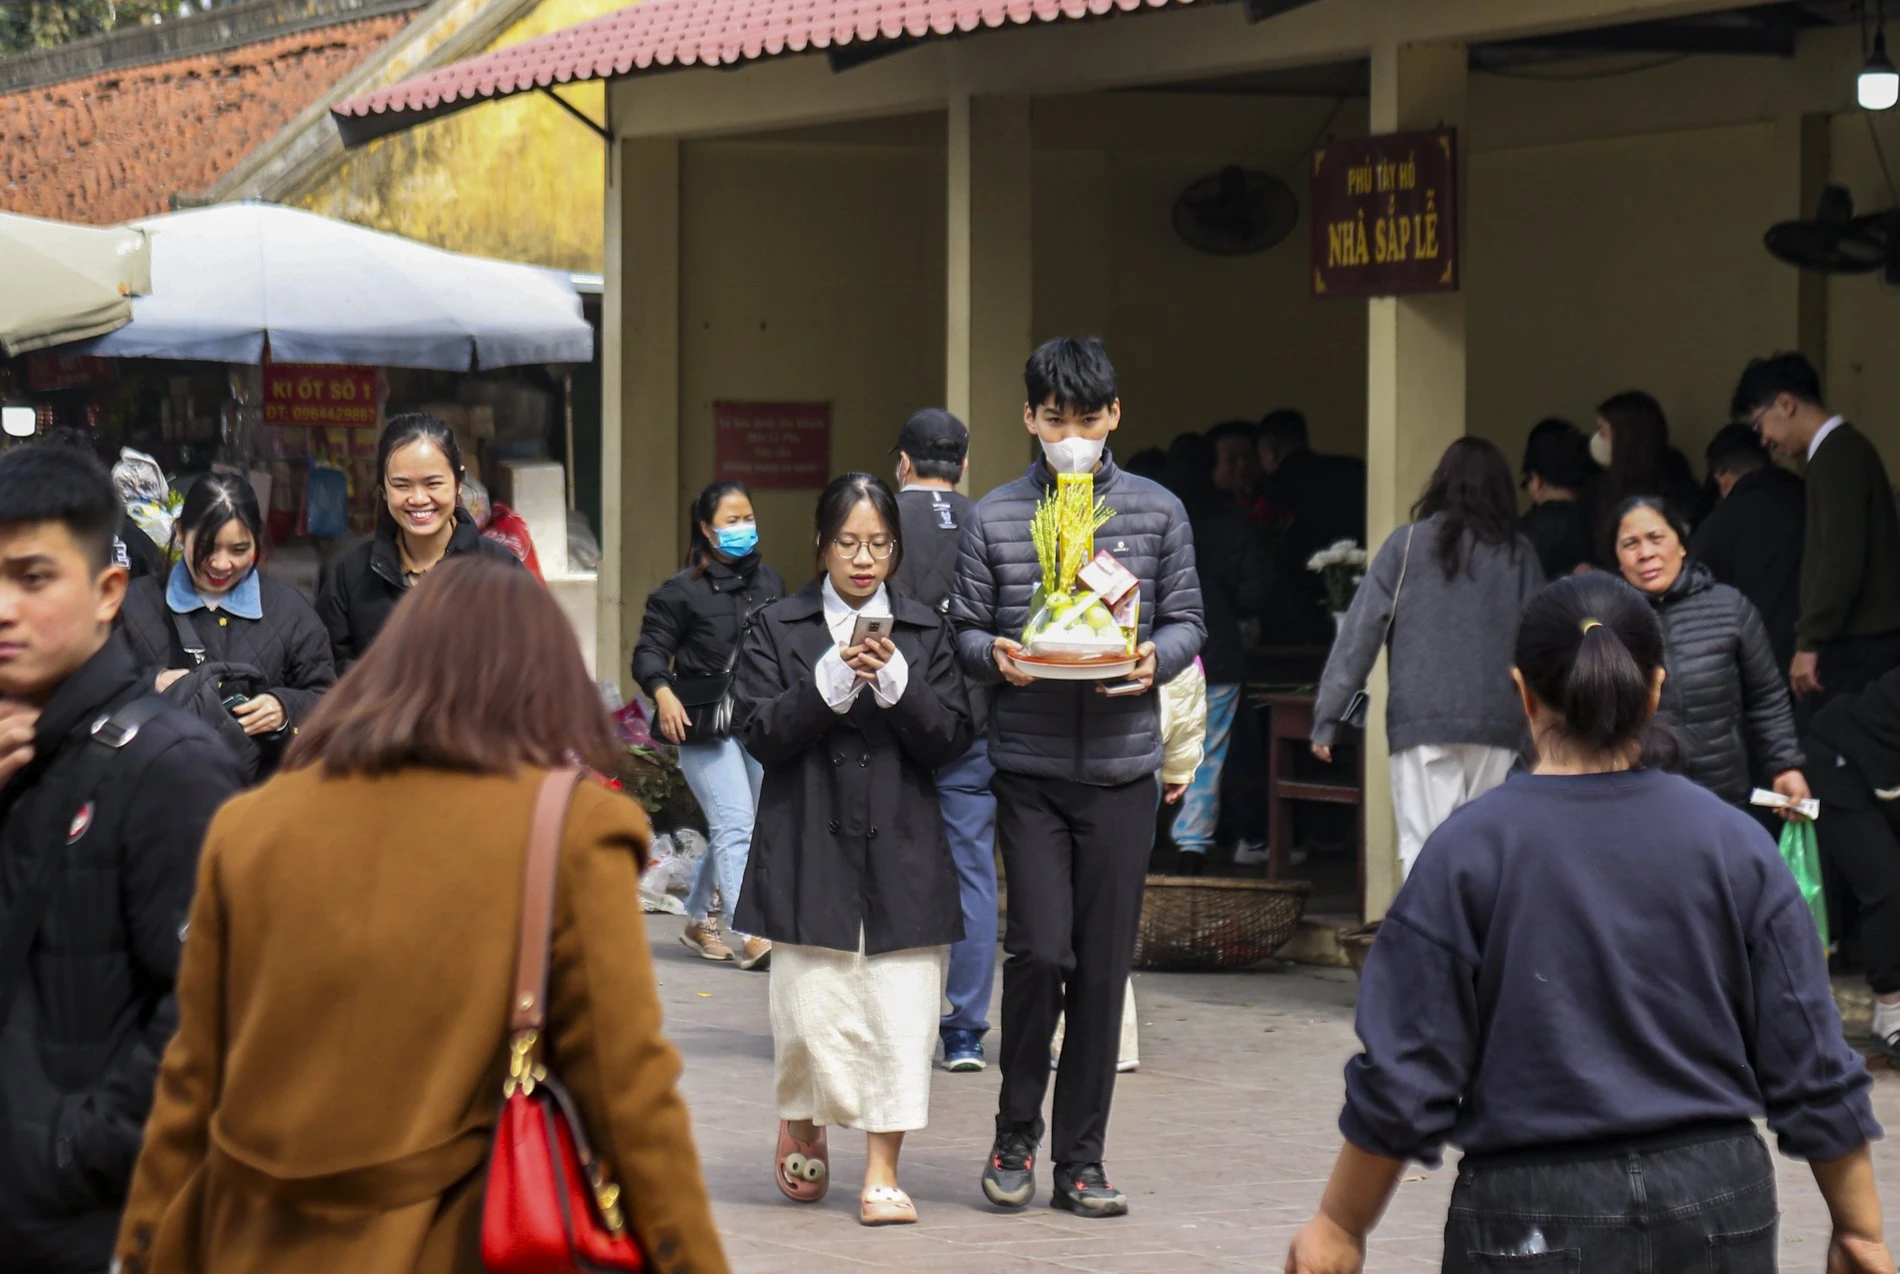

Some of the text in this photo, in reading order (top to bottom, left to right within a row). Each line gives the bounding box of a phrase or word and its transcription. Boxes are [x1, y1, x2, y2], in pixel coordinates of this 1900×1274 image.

[1328, 207, 1370, 268] NHÀ
[1414, 188, 1439, 260] LỄ
[272, 380, 293, 400] KI
[362, 382, 371, 401] 1
